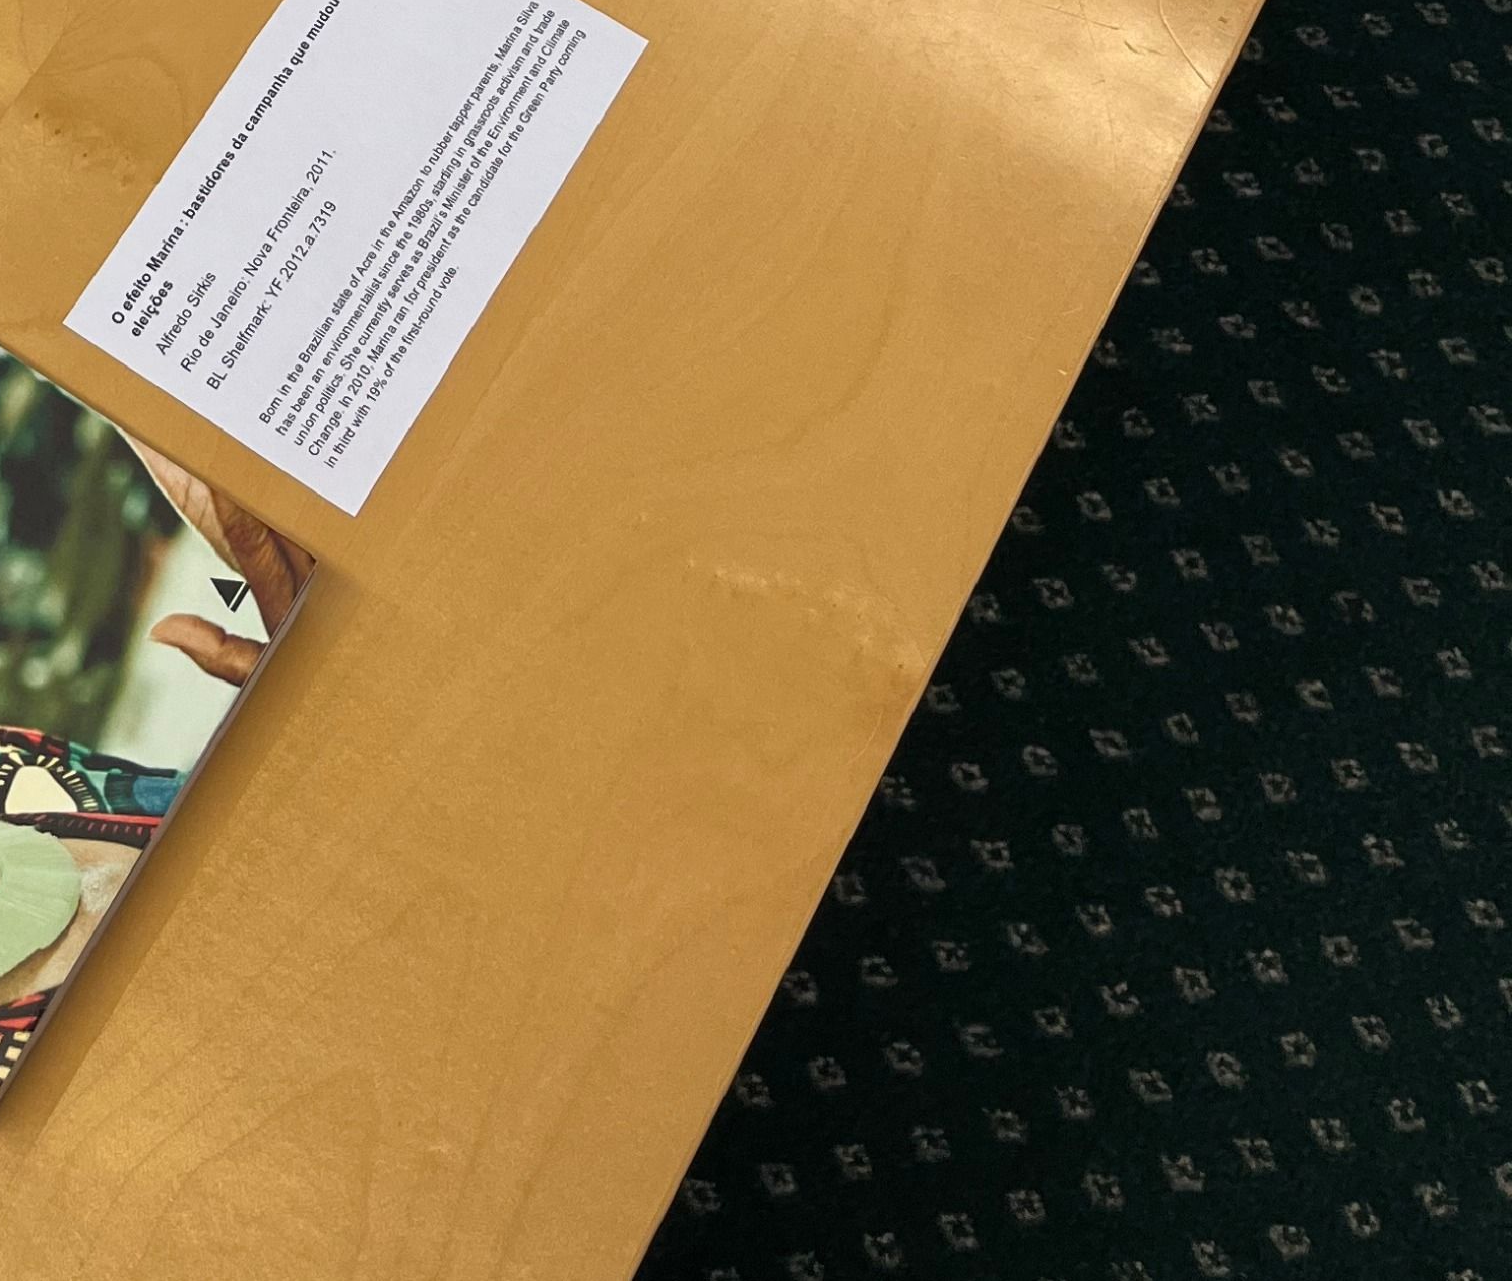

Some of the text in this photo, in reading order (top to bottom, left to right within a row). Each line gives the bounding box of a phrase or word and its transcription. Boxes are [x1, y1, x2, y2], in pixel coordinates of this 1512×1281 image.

[111, 311, 125, 324] O
[122, 272, 152, 312] efeito
[145, 226, 185, 272] Marina
[182, 151, 235, 220] bastidores
[231, 132, 249, 150] da
[244, 67, 294, 132] campanha
[290, 41, 310, 66] que
[180, 150, 336, 373] Rio de Janeiro: Nova Fronteira, 2011.
[131, 280, 174, 337] eleições
[155, 272, 217, 356] Alfredo Sirkis
[206, 200, 337, 390] BL Shelfmark: YF.2012.a.7319
